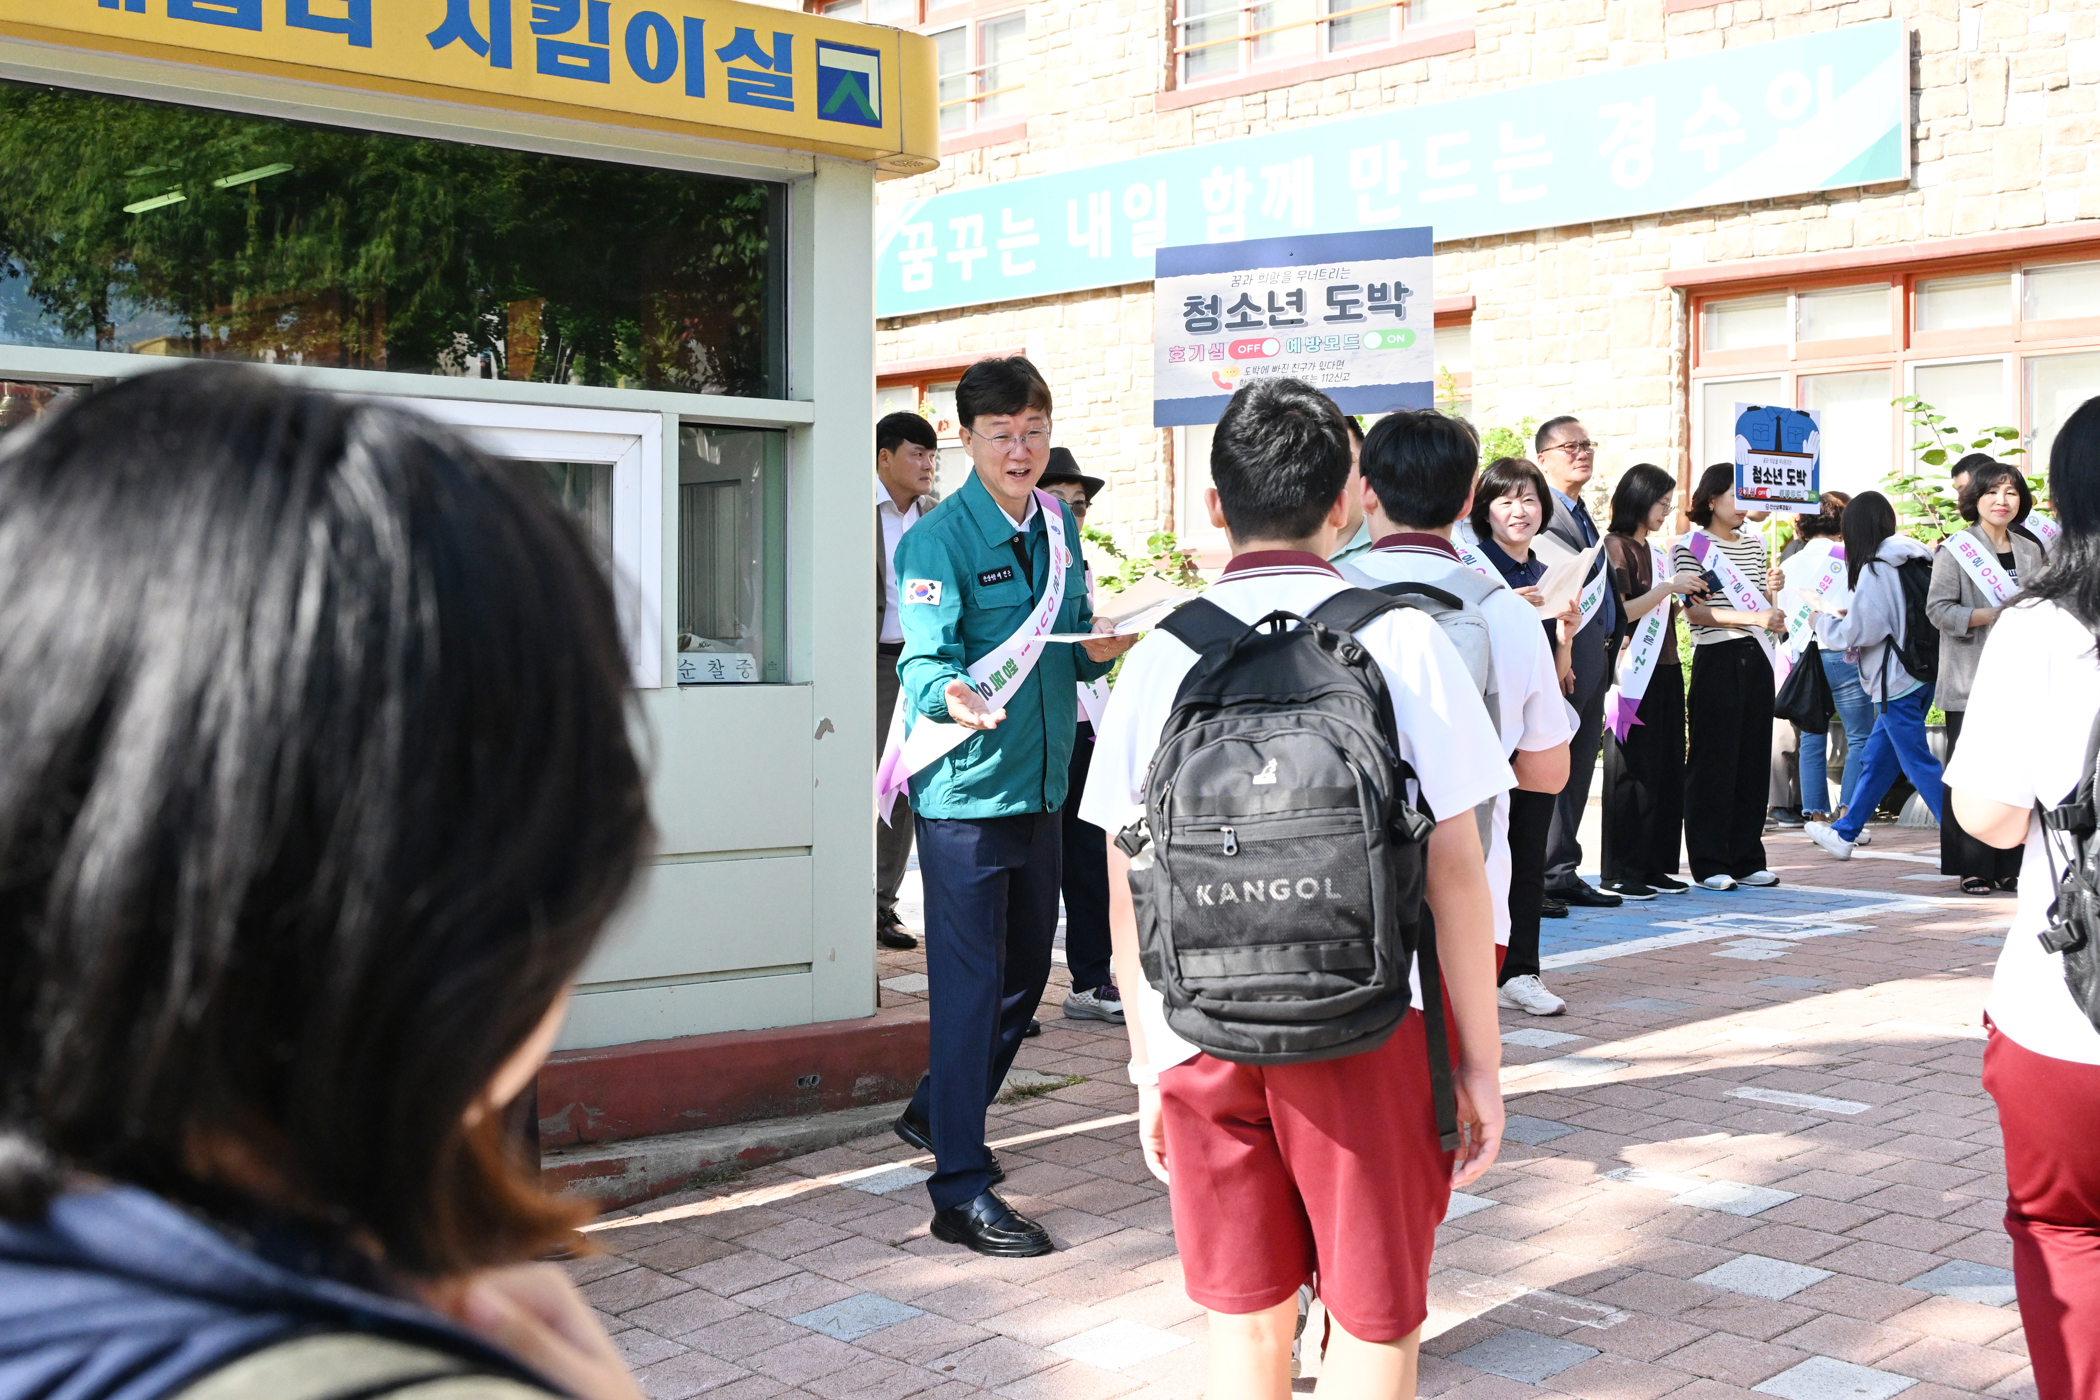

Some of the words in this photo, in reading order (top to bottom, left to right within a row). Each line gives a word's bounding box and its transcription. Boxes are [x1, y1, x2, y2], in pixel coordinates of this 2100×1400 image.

[897, 206, 1041, 293] 꿈꾸는
[1066, 179, 1168, 258] 내일
[1199, 154, 1315, 243] 함께
[1348, 120, 1556, 225] 만드는
[1231, 273, 1254, 288] 꿈과
[1182, 287, 1308, 334] 청소년
[1323, 280, 1414, 323] 도박
[1168, 342, 1225, 363] 호기심
[1237, 343, 1261, 354] OFF
[1286, 333, 1360, 354] 예방모드
[1386, 334, 1405, 344] ON
[1244, 364, 1269, 376] 도박에
[1321, 372, 1351, 383] 112신고
[1752, 465, 1783, 486] 청소년
[1786, 468, 1807, 487] 도박
[1195, 877, 1342, 907] KANGOL
